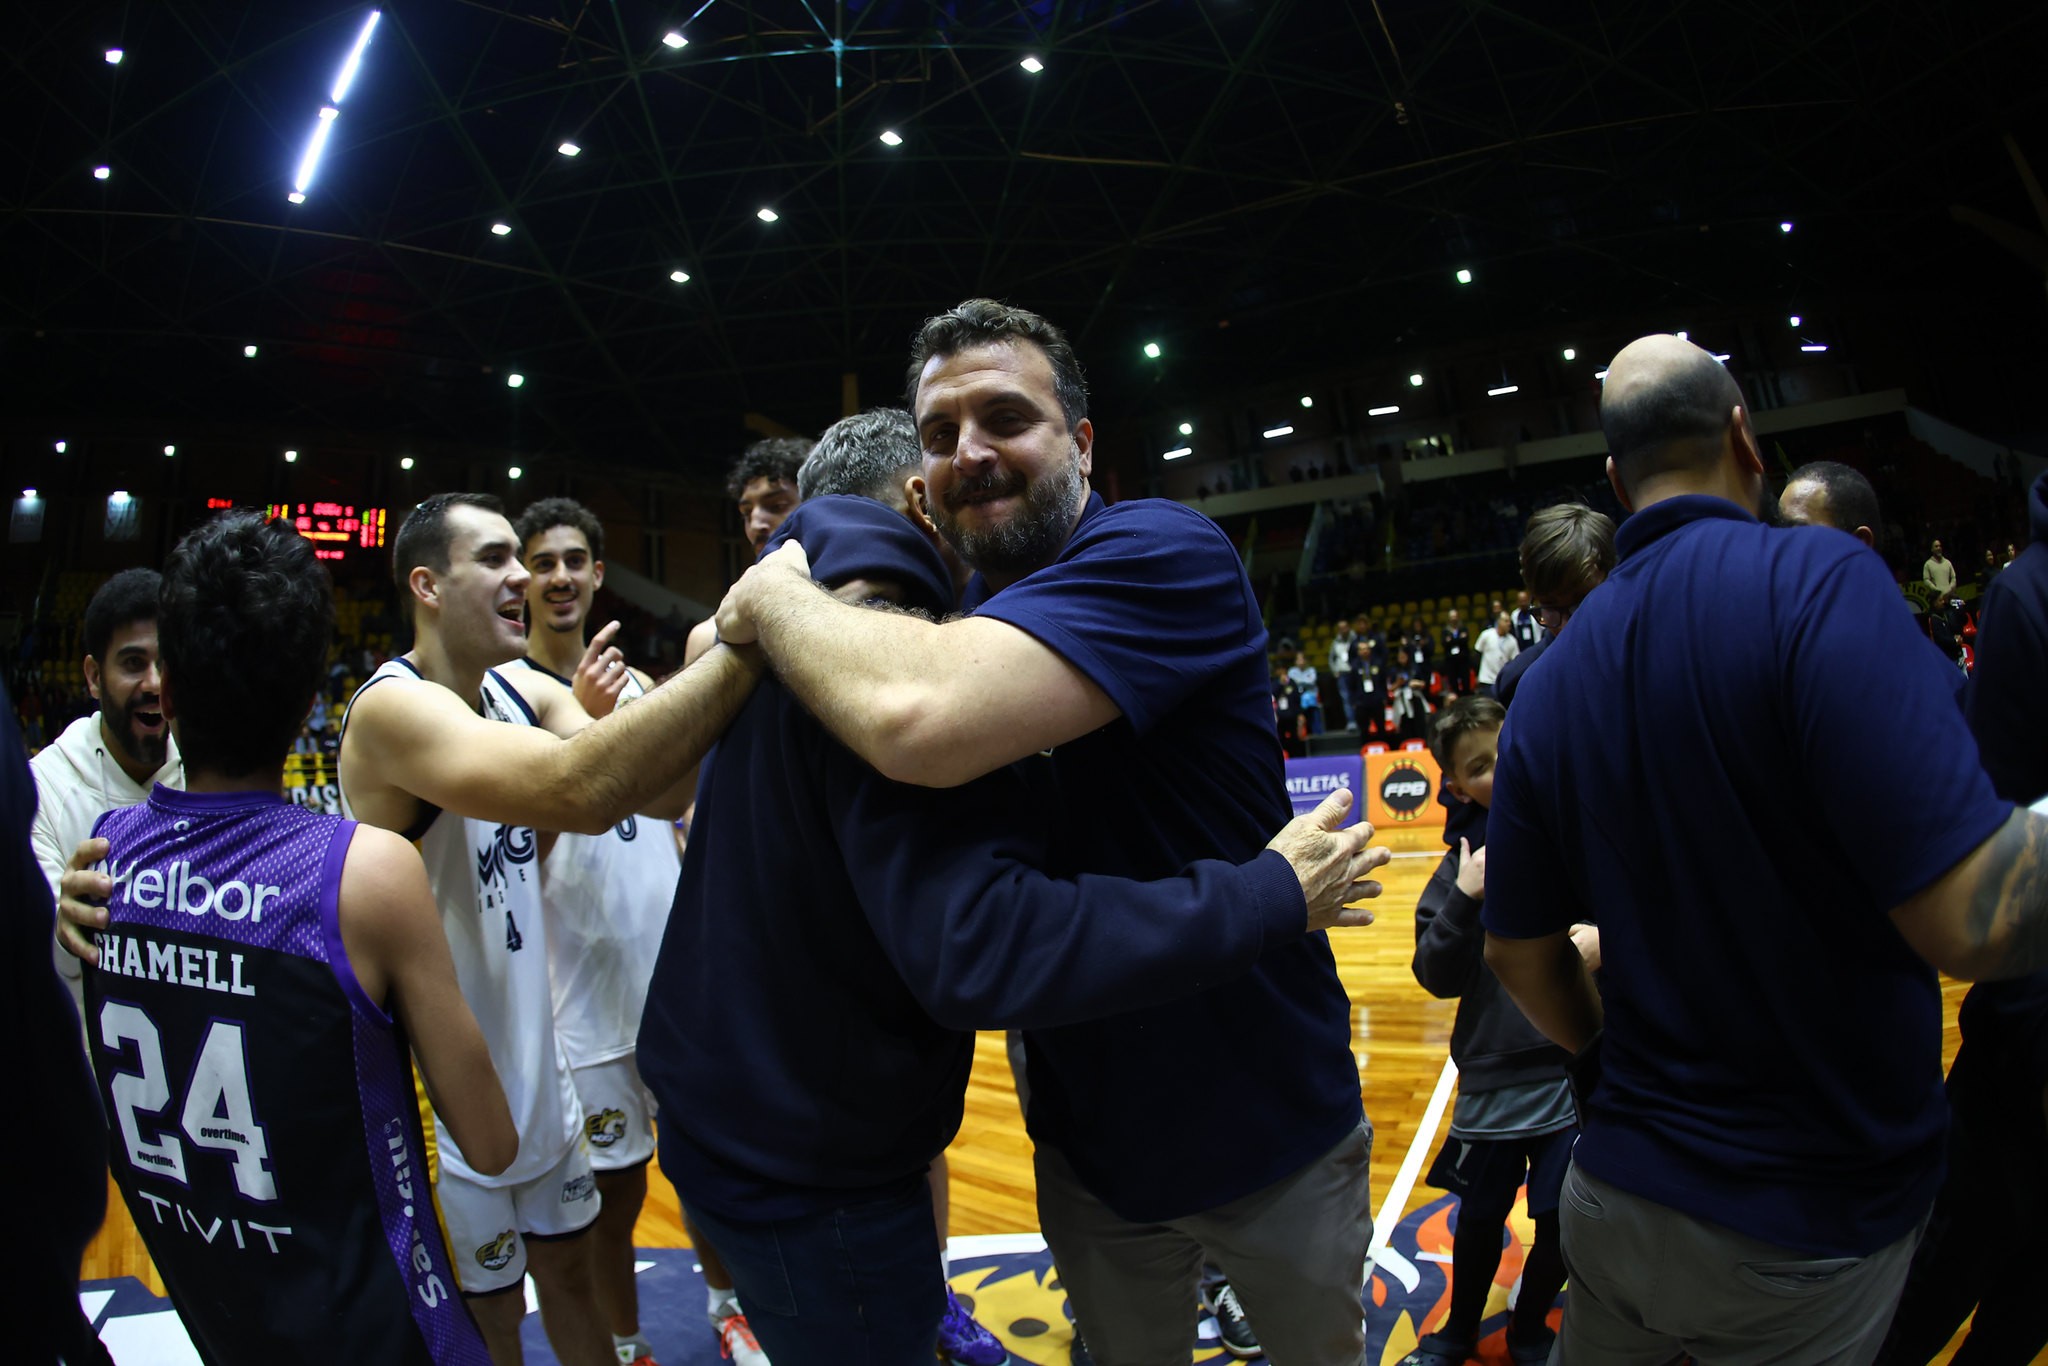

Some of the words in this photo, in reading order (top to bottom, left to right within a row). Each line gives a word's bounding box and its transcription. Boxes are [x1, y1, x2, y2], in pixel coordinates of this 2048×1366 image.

[1384, 781, 1427, 798] FPB
[109, 861, 281, 923] Helbor
[507, 910, 522, 952] 4
[100, 1001, 278, 1200] 24
[138, 1189, 292, 1254] TIVIT
